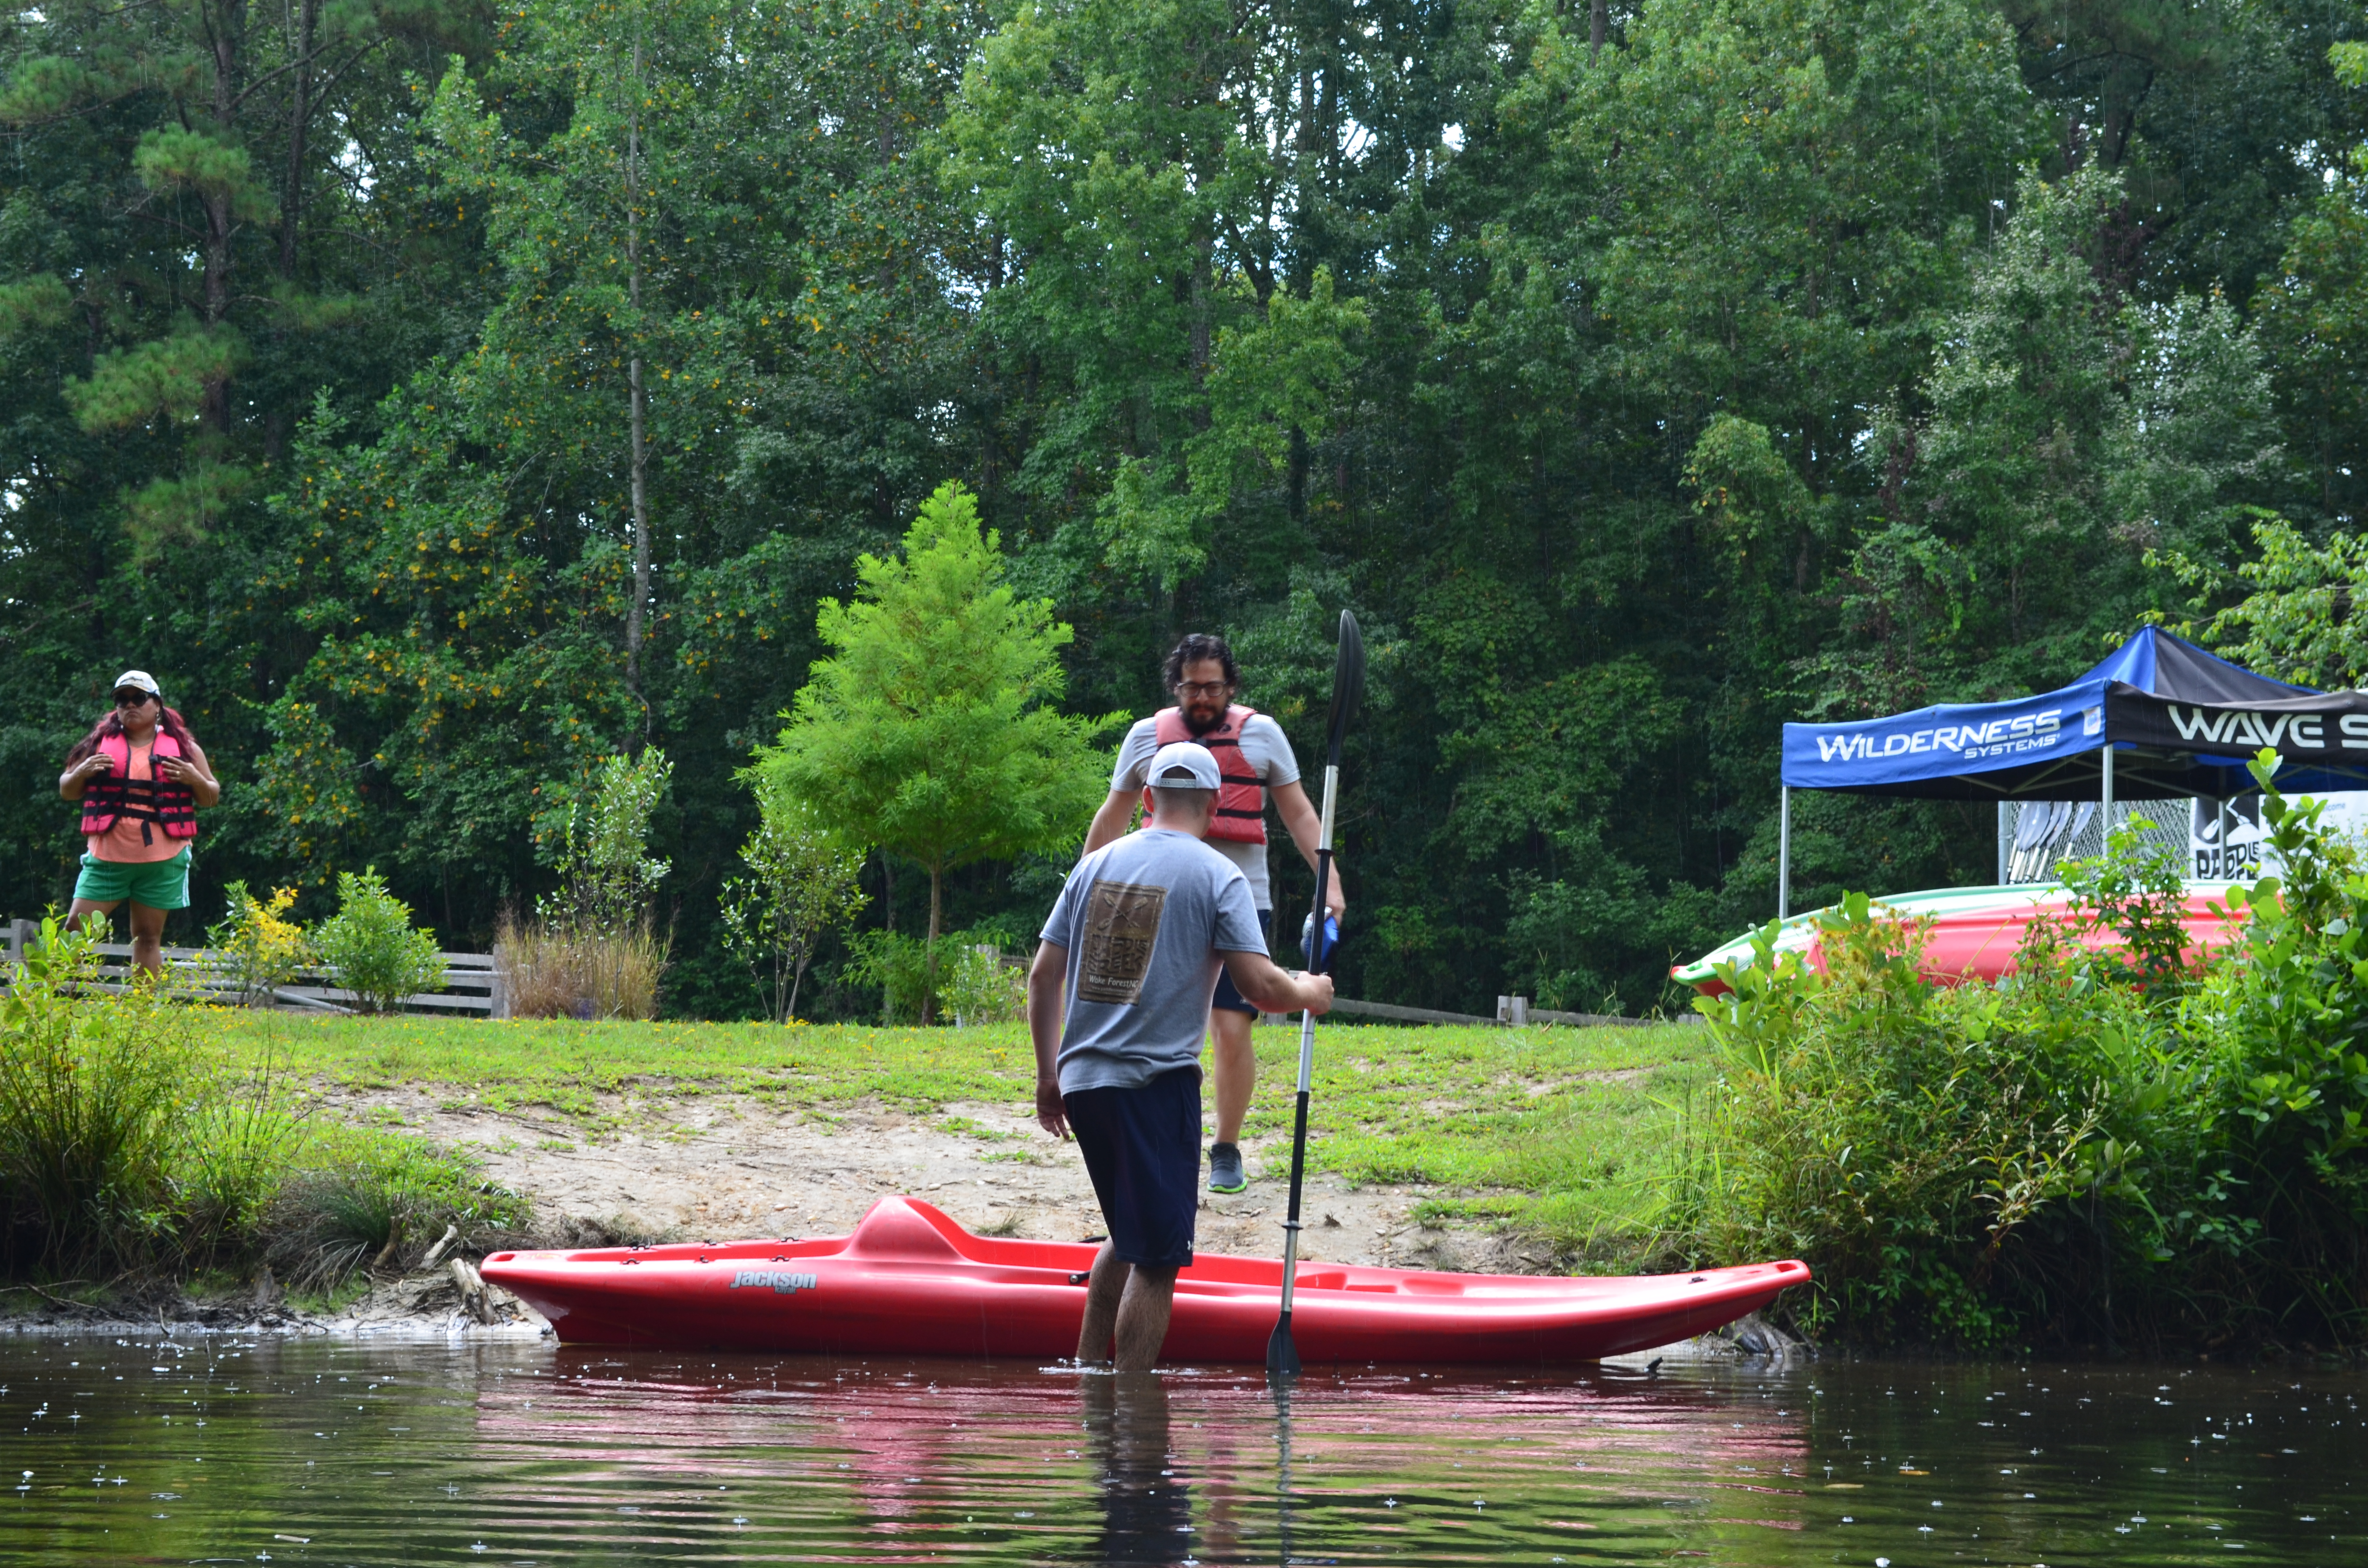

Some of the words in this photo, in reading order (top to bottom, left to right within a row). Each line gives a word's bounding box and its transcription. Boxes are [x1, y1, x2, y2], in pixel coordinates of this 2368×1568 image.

[1816, 710, 2062, 762] WILDERNESS
[2168, 705, 2325, 747] WAVE
[1089, 974, 1105, 985] Wake
